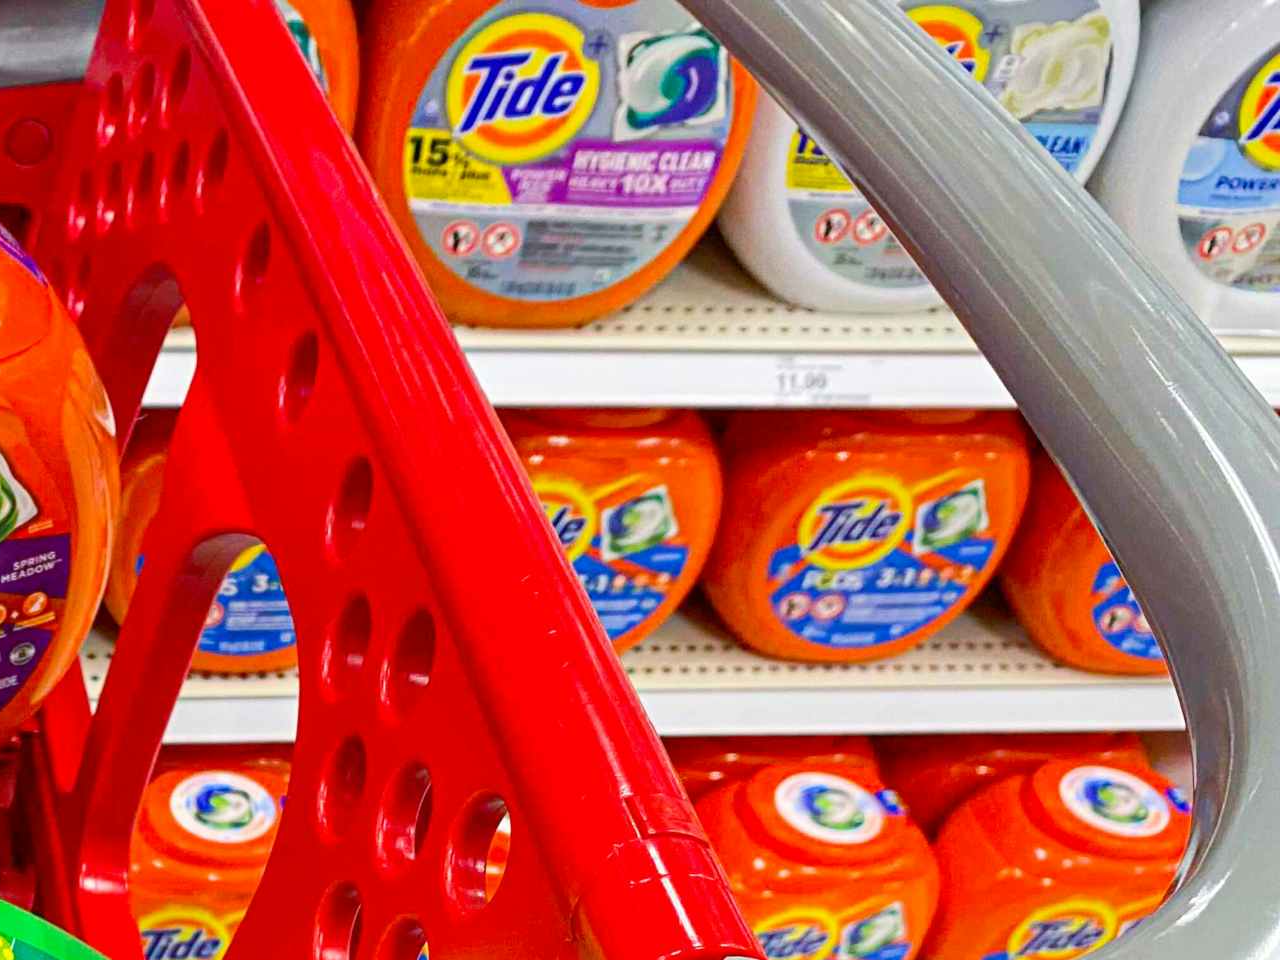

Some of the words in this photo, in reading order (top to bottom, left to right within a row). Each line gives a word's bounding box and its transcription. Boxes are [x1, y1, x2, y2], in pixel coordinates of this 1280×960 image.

[459, 50, 587, 135] Tide
[658, 152, 716, 173] CLEAN
[620, 173, 670, 194] 10X
[808, 500, 903, 554] Tide
[12, 551, 57, 571] SPRING
[0, 562, 56, 584] MEADOW
[1015, 918, 1105, 956] Tide
